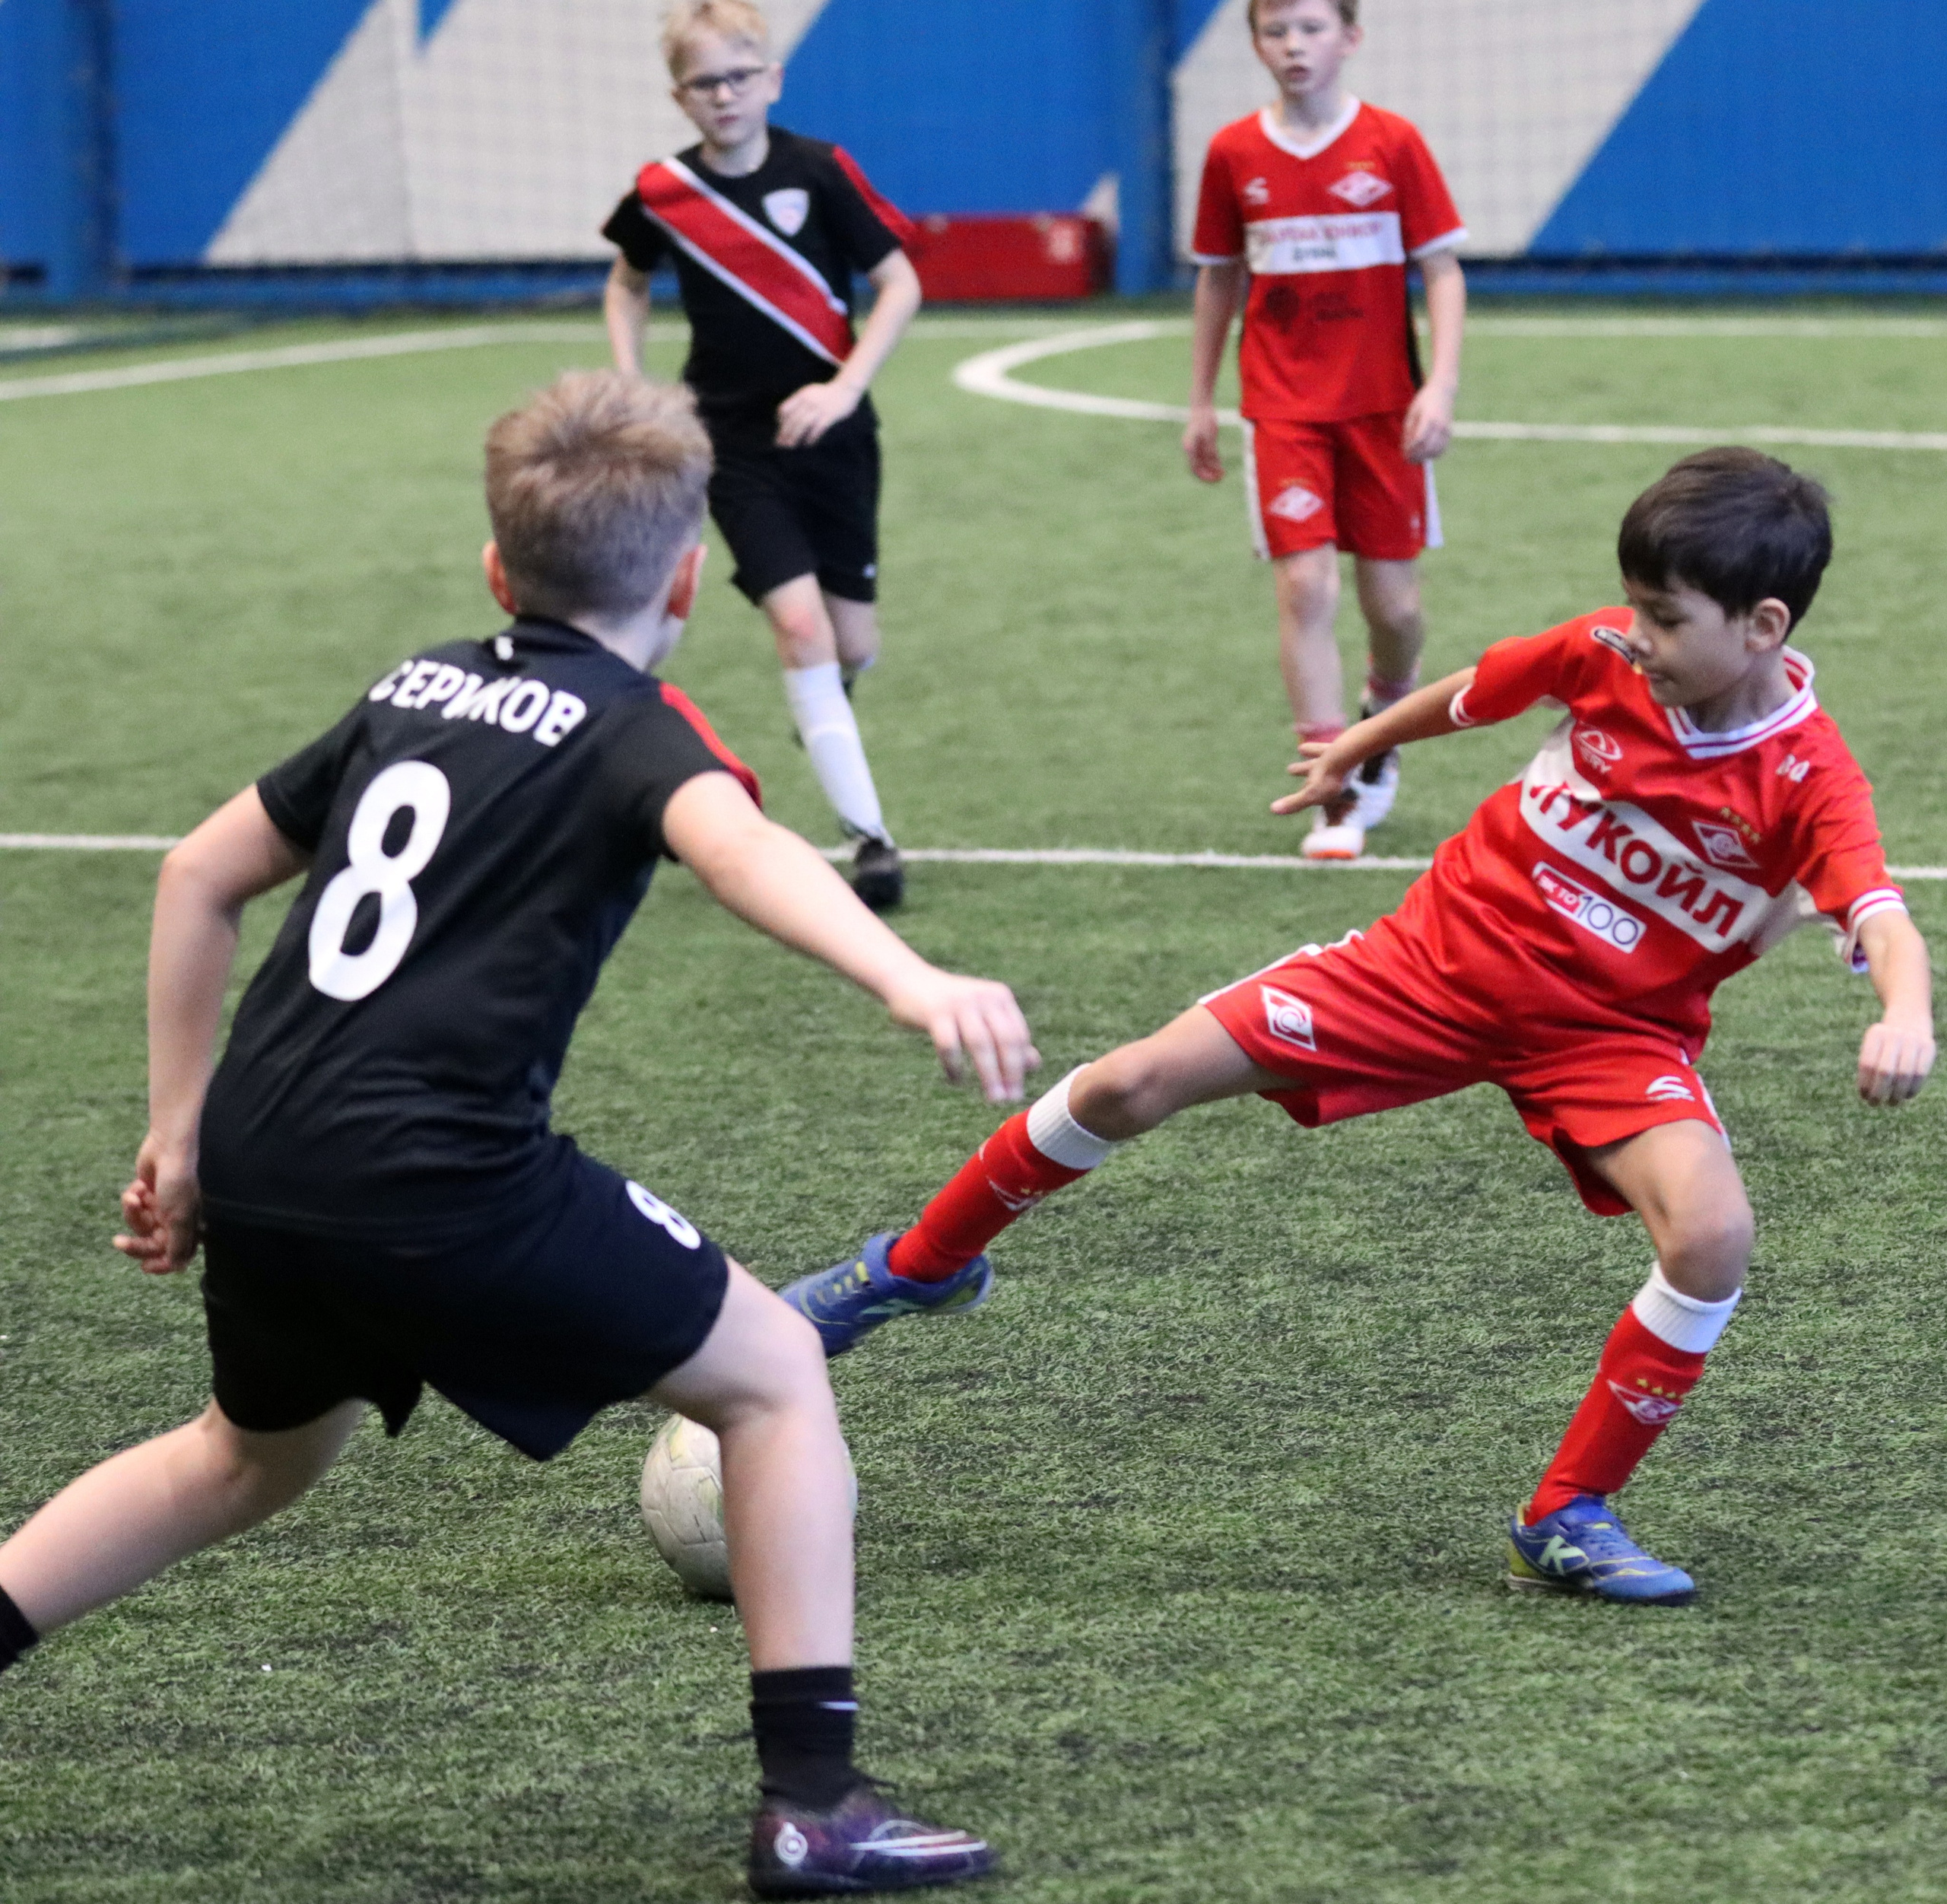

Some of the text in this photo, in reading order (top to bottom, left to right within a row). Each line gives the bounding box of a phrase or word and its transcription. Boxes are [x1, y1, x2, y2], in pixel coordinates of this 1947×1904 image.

[308, 760, 452, 1002] 8
[1577, 895, 1639, 946] 100
[625, 1180, 701, 1250] 8
